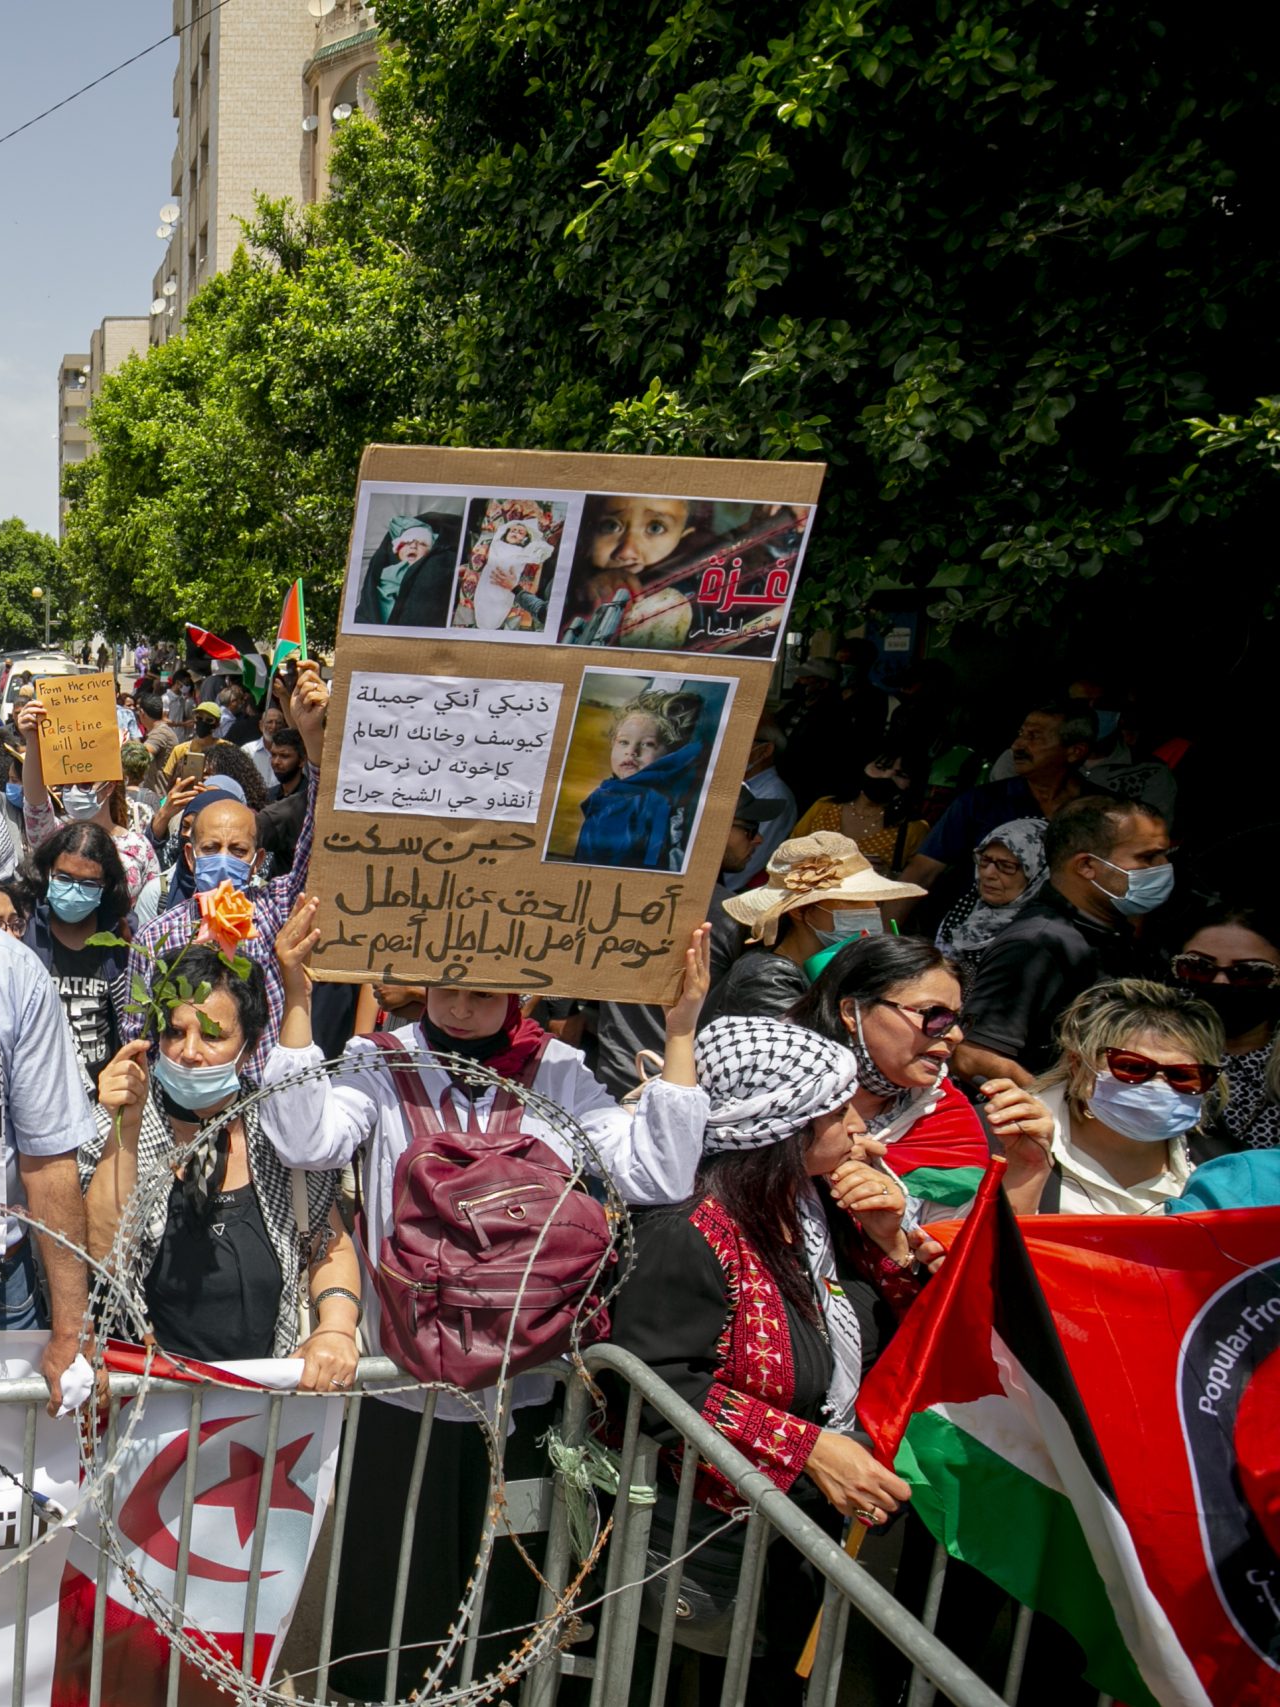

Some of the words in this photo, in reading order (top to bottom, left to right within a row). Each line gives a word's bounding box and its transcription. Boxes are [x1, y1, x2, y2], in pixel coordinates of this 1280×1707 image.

[697, 555, 790, 613] غزة
[689, 615, 744, 639] الحصار
[39, 682, 62, 695] From
[68, 680, 84, 691] the
[87, 679, 113, 689] river
[356, 686, 424, 709] جميلة
[51, 697, 60, 706] to
[64, 694, 79, 704] the
[81, 694, 99, 703] sea
[433, 688, 480, 716] أنكي
[488, 694, 550, 719] ذنبكي
[40, 718, 103, 738] Palestine
[352, 721, 399, 745] العالم
[407, 726, 465, 746] وخانك
[52, 736, 72, 751] will
[80, 737, 98, 750] be
[474, 729, 548, 753] كيوسف
[363, 754, 411, 774] نرحل
[418, 758, 441, 775] لن
[448, 760, 513, 781] كإخوته
[342, 784, 385, 804] جراح
[391, 787, 442, 808] الشيخ
[447, 795, 478, 812] حي
[484, 790, 534, 810] أنقذو
[323, 823, 423, 855] سكت
[422, 832, 536, 865] حين
[334, 864, 457, 915] الباطل
[456, 886, 498, 908] عن
[497, 879, 592, 926] الحق
[588, 882, 684, 935] أهل
[425, 909, 524, 963] الباطل
[524, 924, 588, 965] أهل
[1198, 1325, 1252, 1417] Popular
